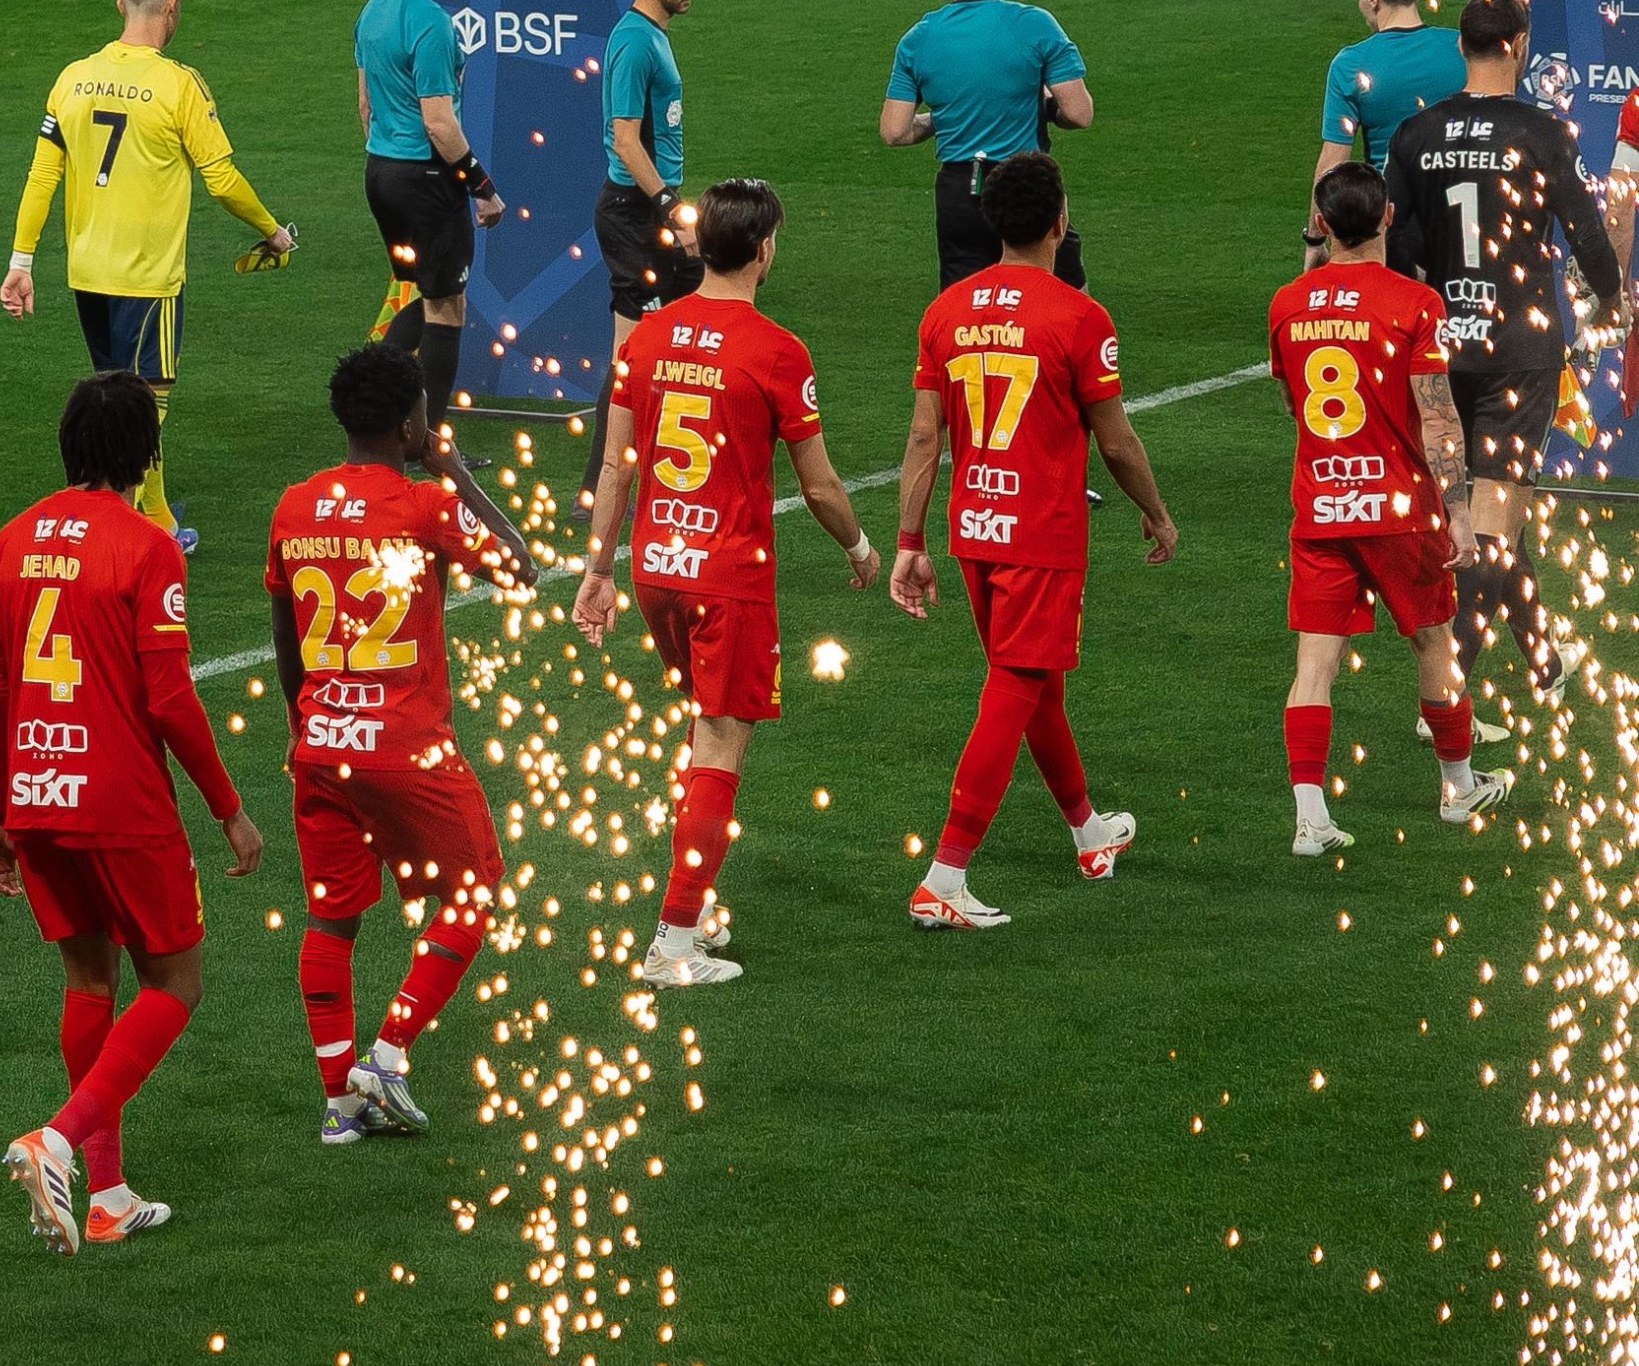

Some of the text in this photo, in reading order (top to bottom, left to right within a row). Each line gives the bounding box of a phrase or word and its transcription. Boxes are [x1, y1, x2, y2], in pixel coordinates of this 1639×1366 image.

[494, 11, 578, 55] BSF
[74, 82, 153, 102] RONALDO
[1589, 94, 1630, 104] PRESEN
[92, 109, 128, 187] 7
[1420, 150, 1515, 171] CASTEELS
[1446, 182, 1480, 268] 1
[954, 321, 1025, 348] GASTÓN
[1290, 319, 1370, 342] NAHITAN
[652, 360, 726, 390] J.WEIGL
[1303, 345, 1366, 438] 8
[945, 352, 1039, 450] 17
[653, 390, 712, 492] 5
[20, 554, 80, 580] JEHAD
[292, 566, 417, 671] 22
[22, 588, 82, 702] 4
